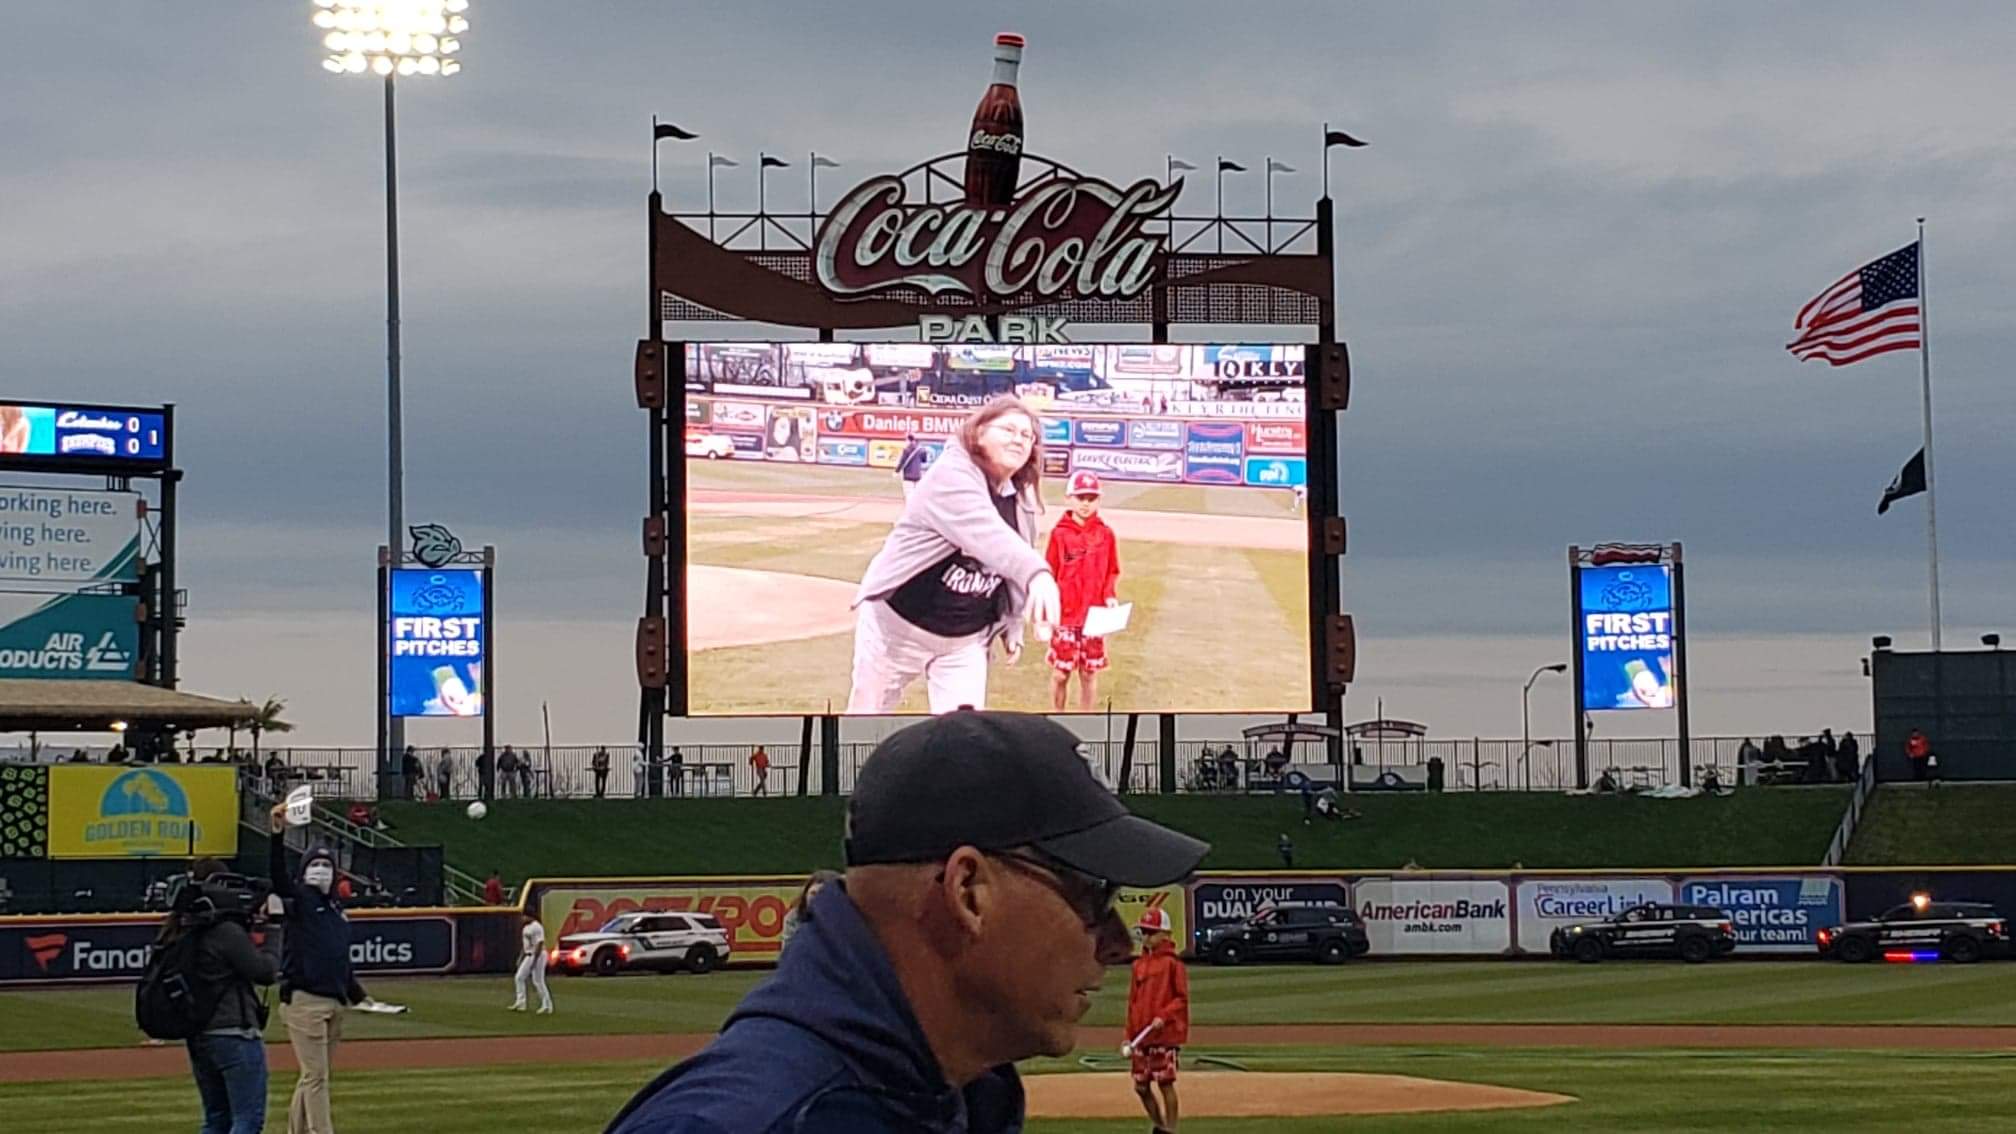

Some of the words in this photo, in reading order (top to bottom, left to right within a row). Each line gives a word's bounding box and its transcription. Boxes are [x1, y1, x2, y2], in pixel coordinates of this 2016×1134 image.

[816, 177, 1182, 297] Coca-Cola
[919, 314, 1071, 344] PARK
[127, 417, 140, 433] 0
[863, 413, 919, 432] Daniels
[922, 416, 966, 434] BMW
[127, 438, 140, 454] 0
[68, 495, 117, 515] here.
[0, 521, 35, 546] ing
[41, 522, 91, 543] here.
[47, 552, 97, 572] here.
[394, 617, 481, 641] FIRST
[1586, 612, 1669, 635] FIRST
[44, 633, 85, 651] AIR
[394, 639, 481, 657] PITCHES
[1586, 634, 1670, 652] PITCHES
[0, 650, 83, 670] ODUCTS
[85, 819, 151, 842] GOLDEN
[1222, 887, 1246, 900] on
[1251, 887, 1294, 904] your
[1691, 883, 1779, 905] Palram
[1202, 901, 1254, 918] DUAL
[1361, 899, 1506, 921] AmericanBank
[1721, 904, 1808, 925] ericas
[1404, 921, 1462, 934] ambk.com
[1760, 926, 1807, 941] team!
[73, 942, 152, 970] Fanat
[349, 935, 413, 964] atics
